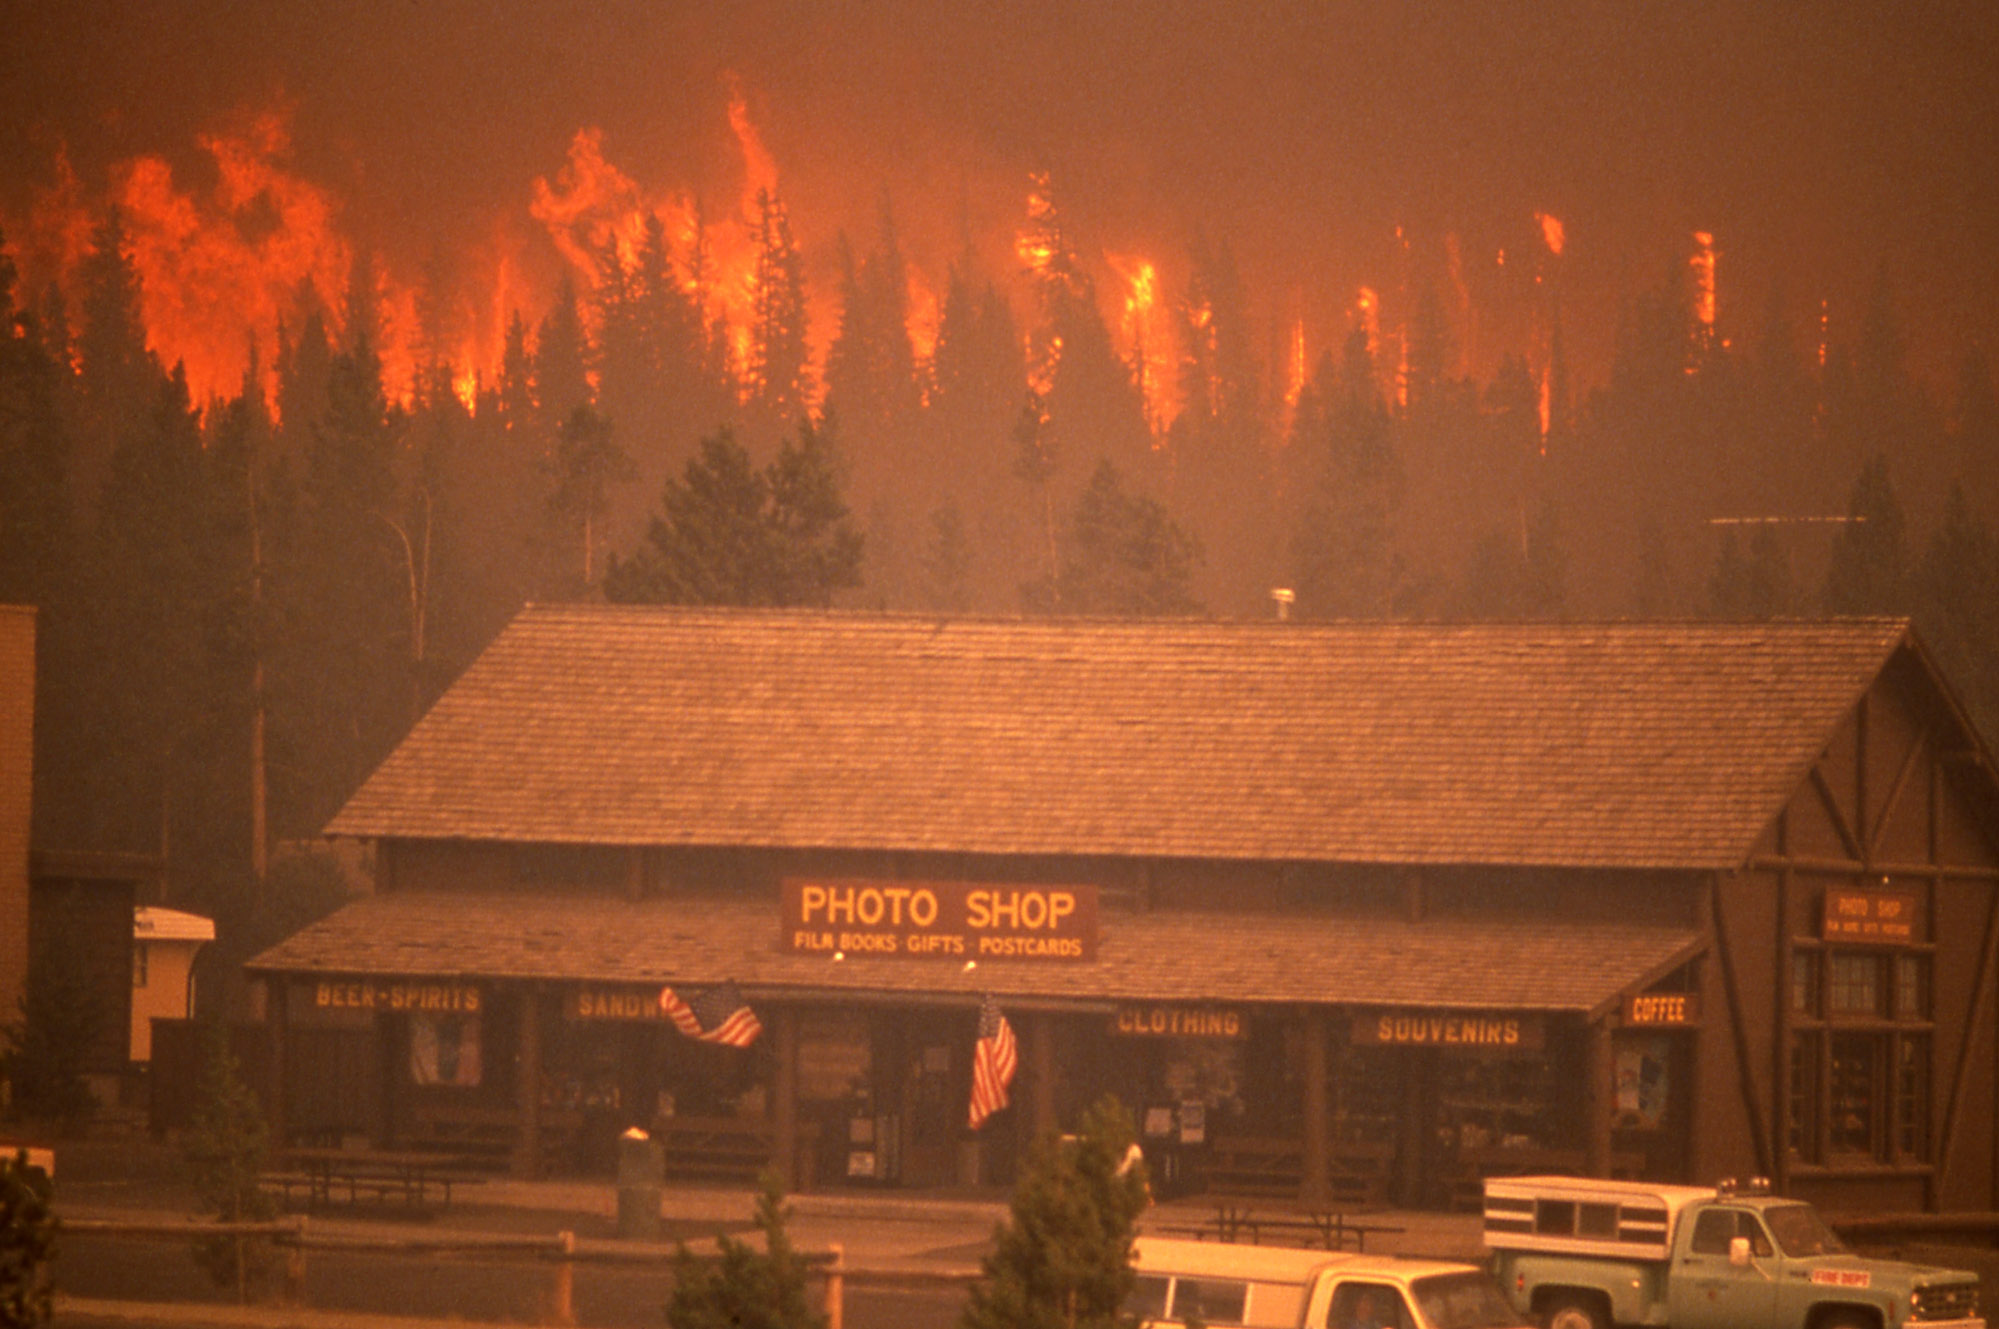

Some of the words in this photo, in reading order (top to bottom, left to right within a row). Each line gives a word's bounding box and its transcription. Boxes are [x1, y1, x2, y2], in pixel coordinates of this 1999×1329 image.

[802, 886, 938, 927] PHOTO
[966, 890, 1076, 930] SHOP
[794, 931, 834, 950] FILM
[840, 932, 898, 952] BOOKS
[907, 933, 965, 954] GIFTS
[979, 937, 1083, 956] POSTCARDS
[578, 993, 662, 1017] SANDW
[1633, 997, 1686, 1022] COFFEE
[1118, 1008, 1239, 1036] CLOTHING
[1378, 1016, 1519, 1044] SOUVENIRS
